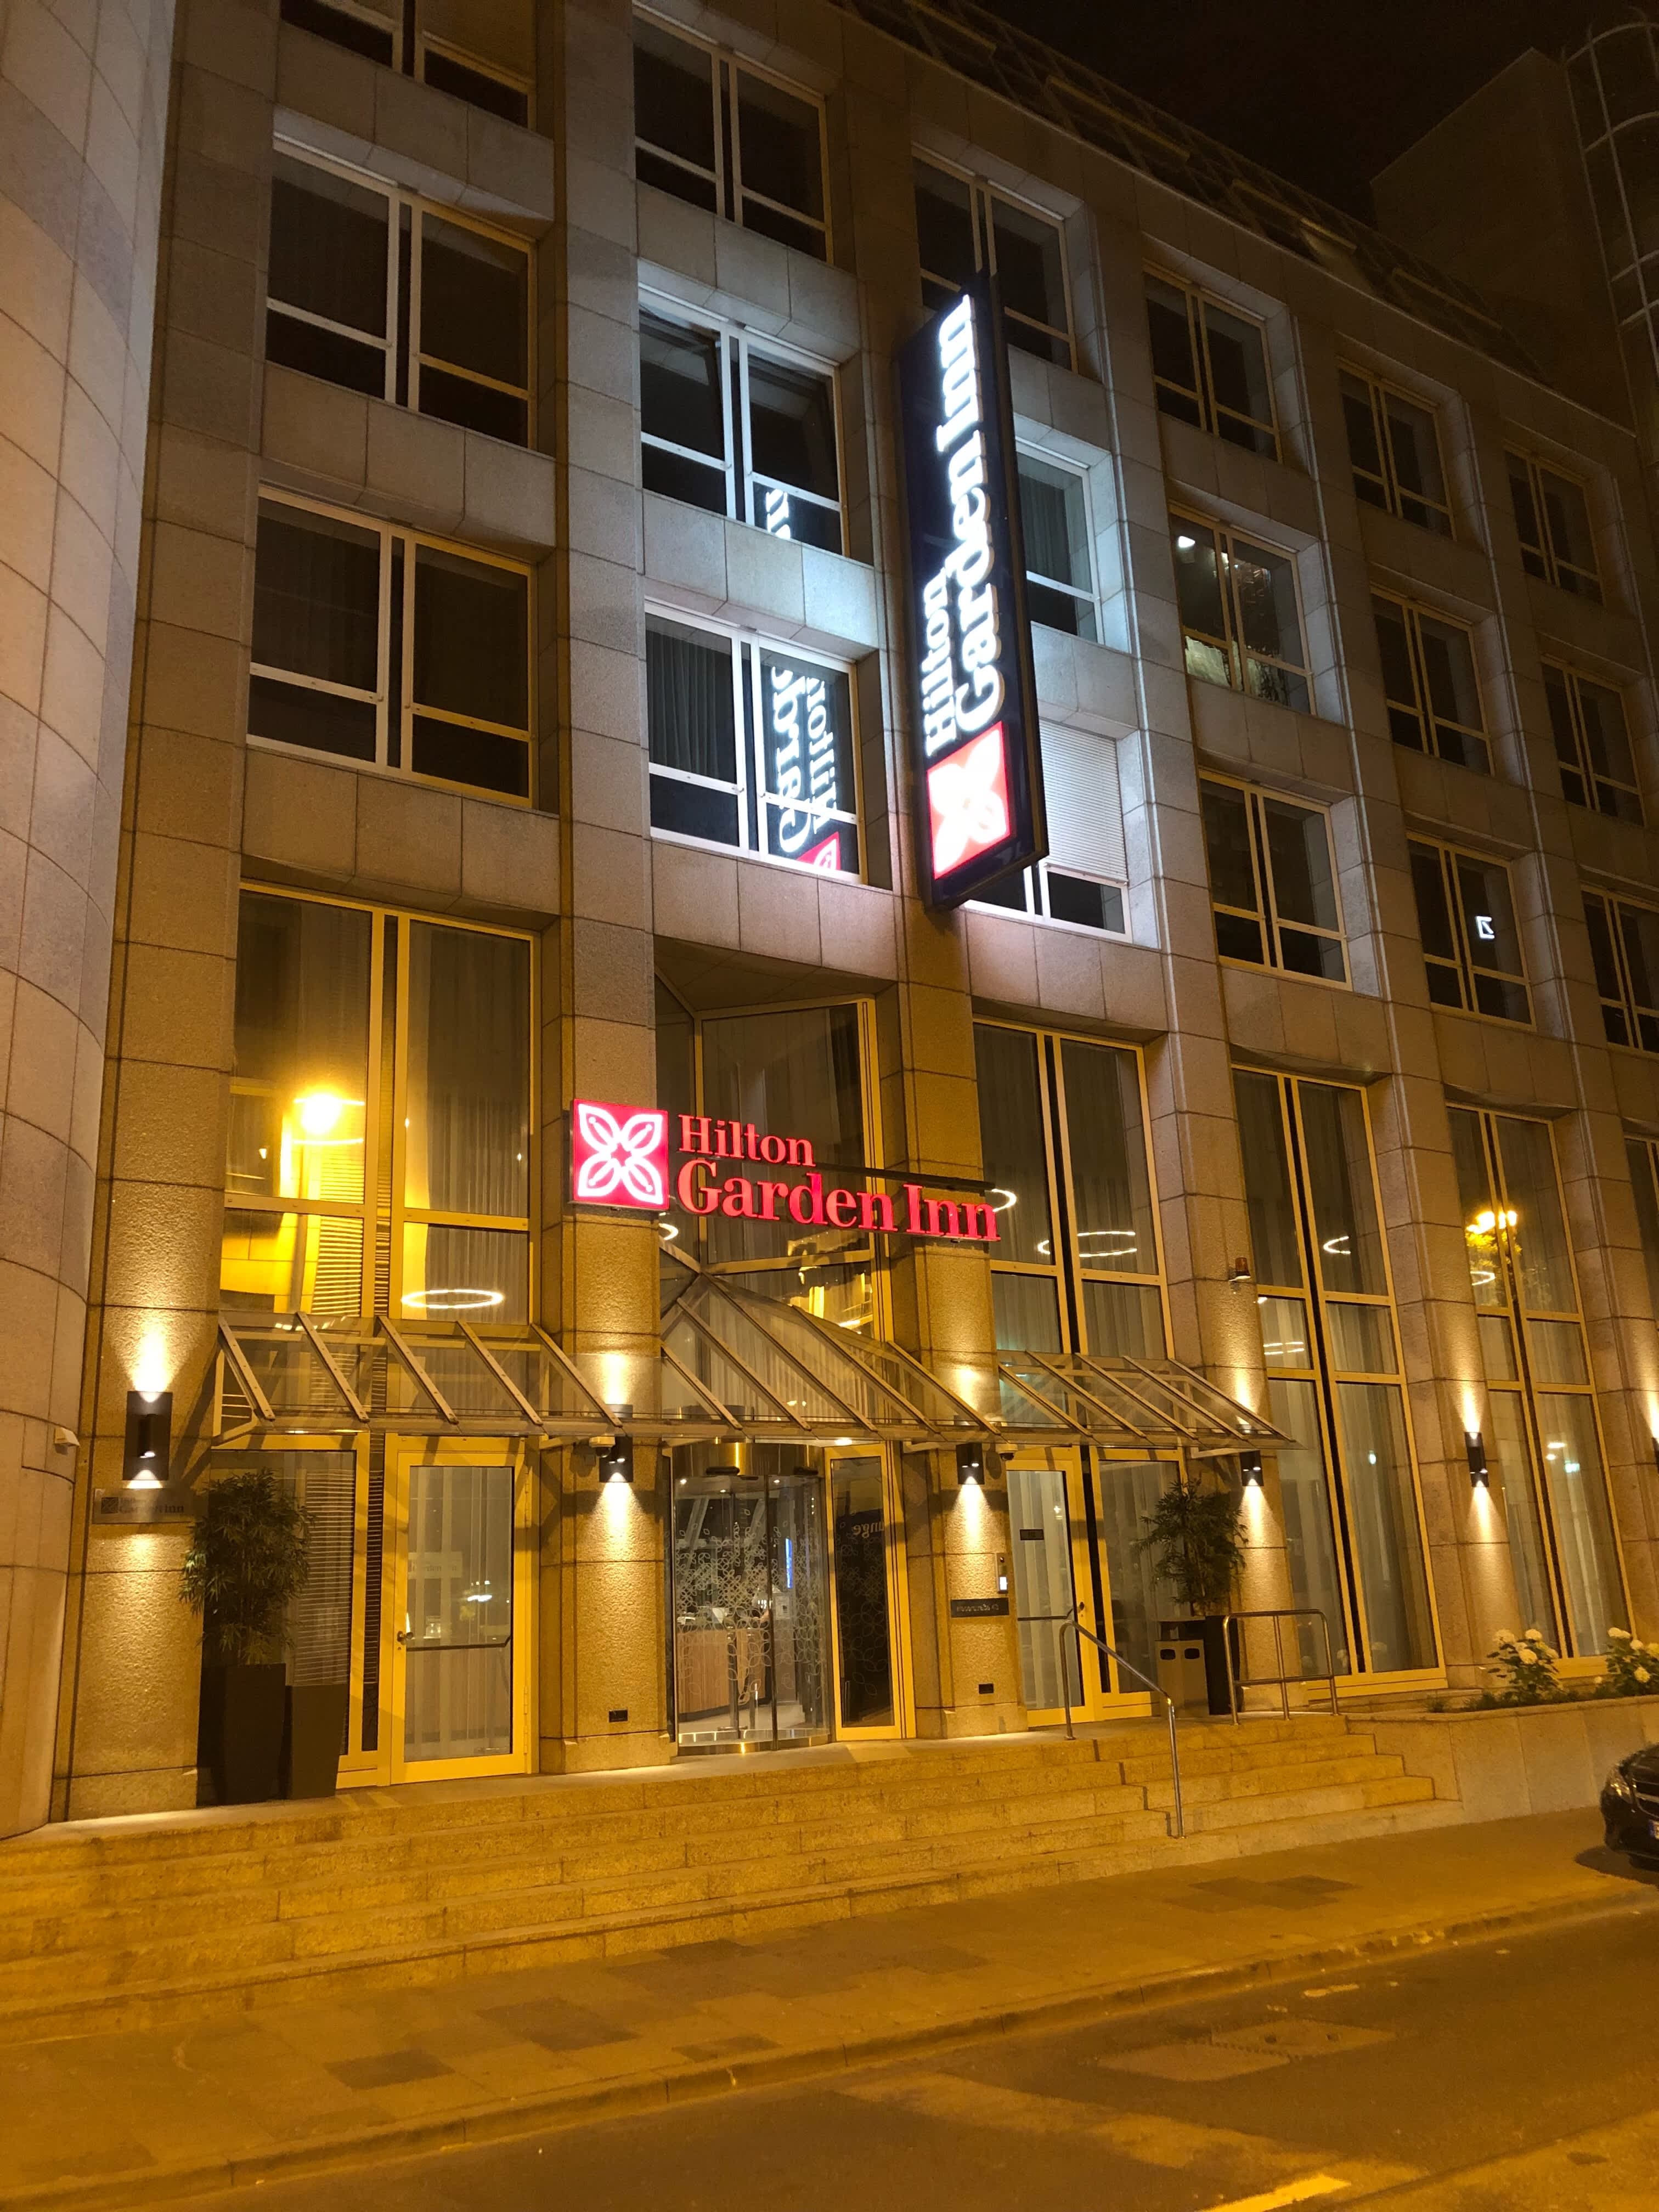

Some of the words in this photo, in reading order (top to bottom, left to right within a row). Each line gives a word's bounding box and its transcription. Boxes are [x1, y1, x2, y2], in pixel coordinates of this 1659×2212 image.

[936, 294, 980, 452] Inn
[945, 430, 1000, 731] Garden
[922, 567, 957, 757] Hilton
[677, 1158, 898, 1232] Garden
[902, 1183, 1001, 1242] Inn
[678, 1114, 816, 1167] Hilton
